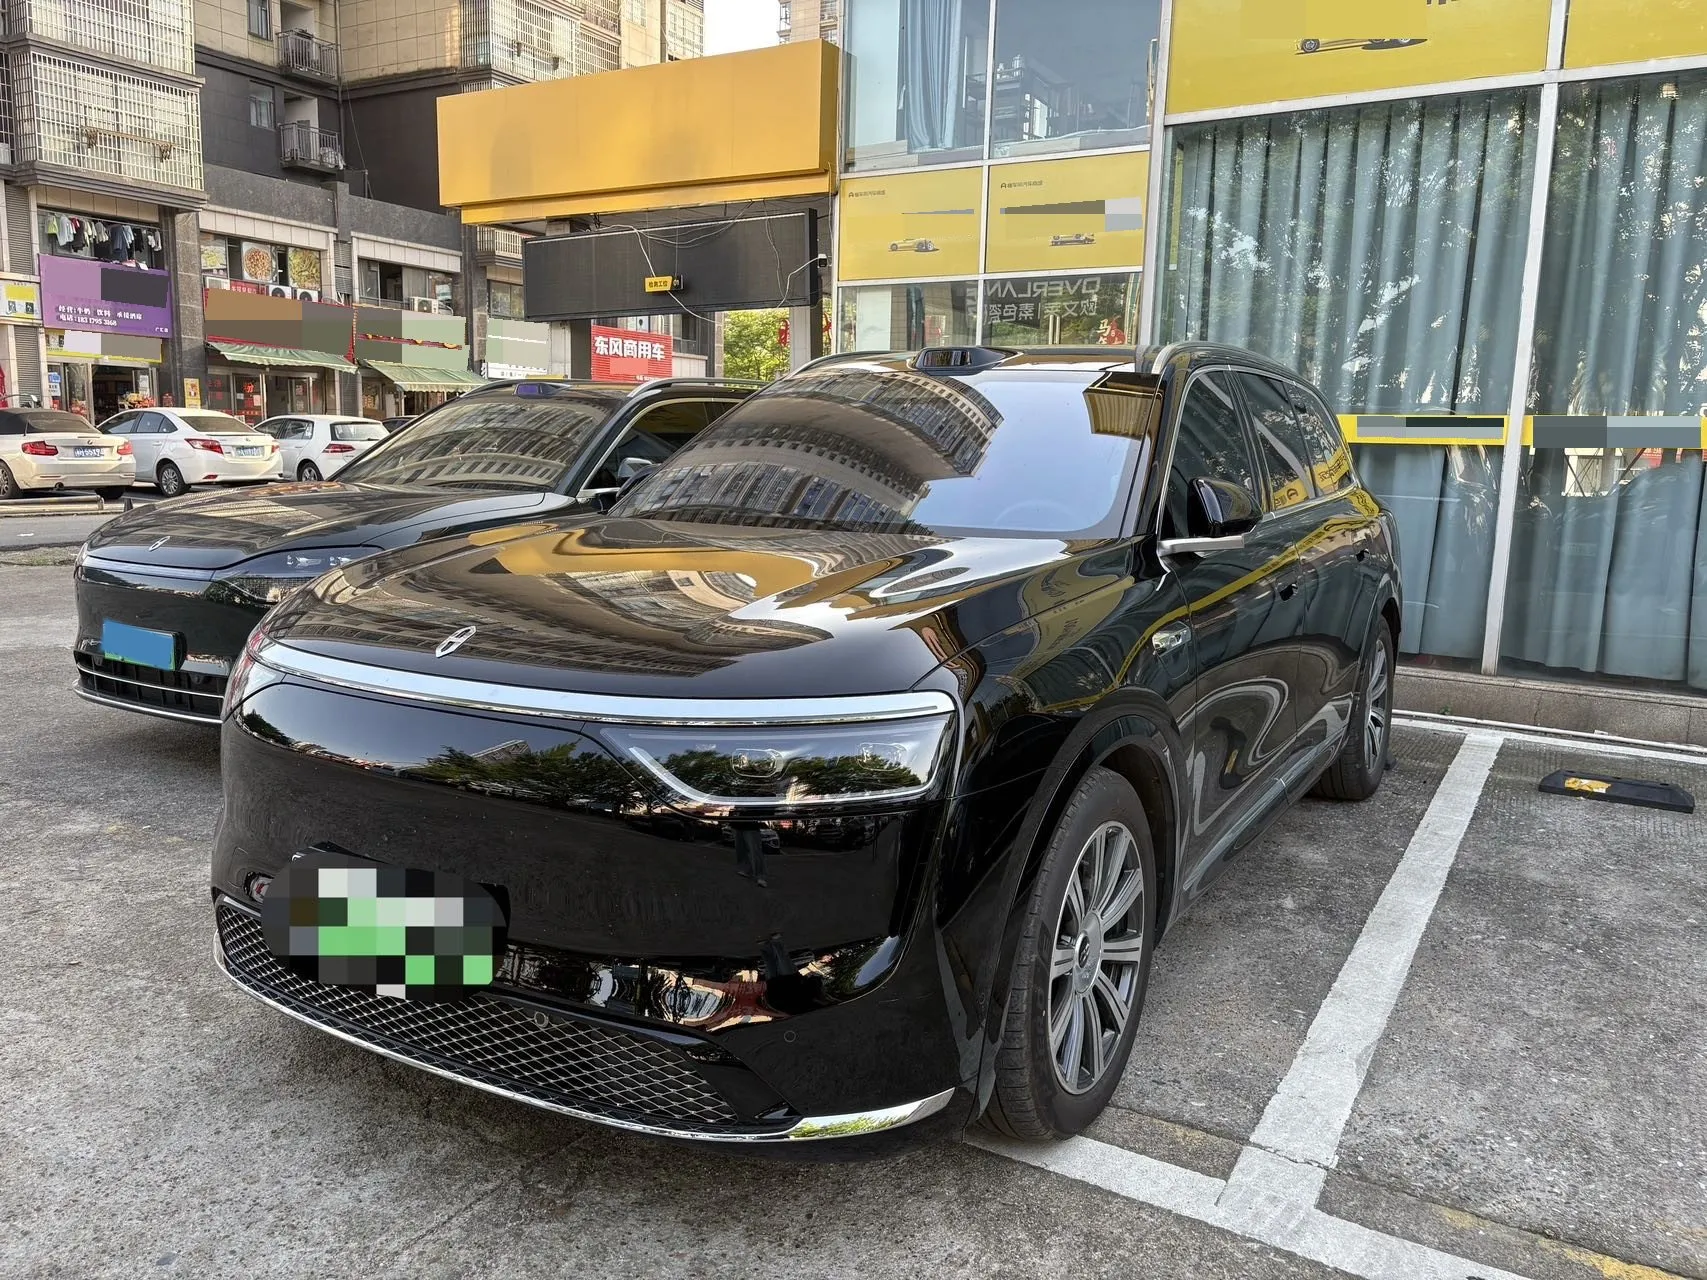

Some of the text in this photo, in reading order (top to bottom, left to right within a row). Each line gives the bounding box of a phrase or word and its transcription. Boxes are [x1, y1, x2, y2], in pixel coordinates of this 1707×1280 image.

[594, 335, 666, 361] 东风商用车
